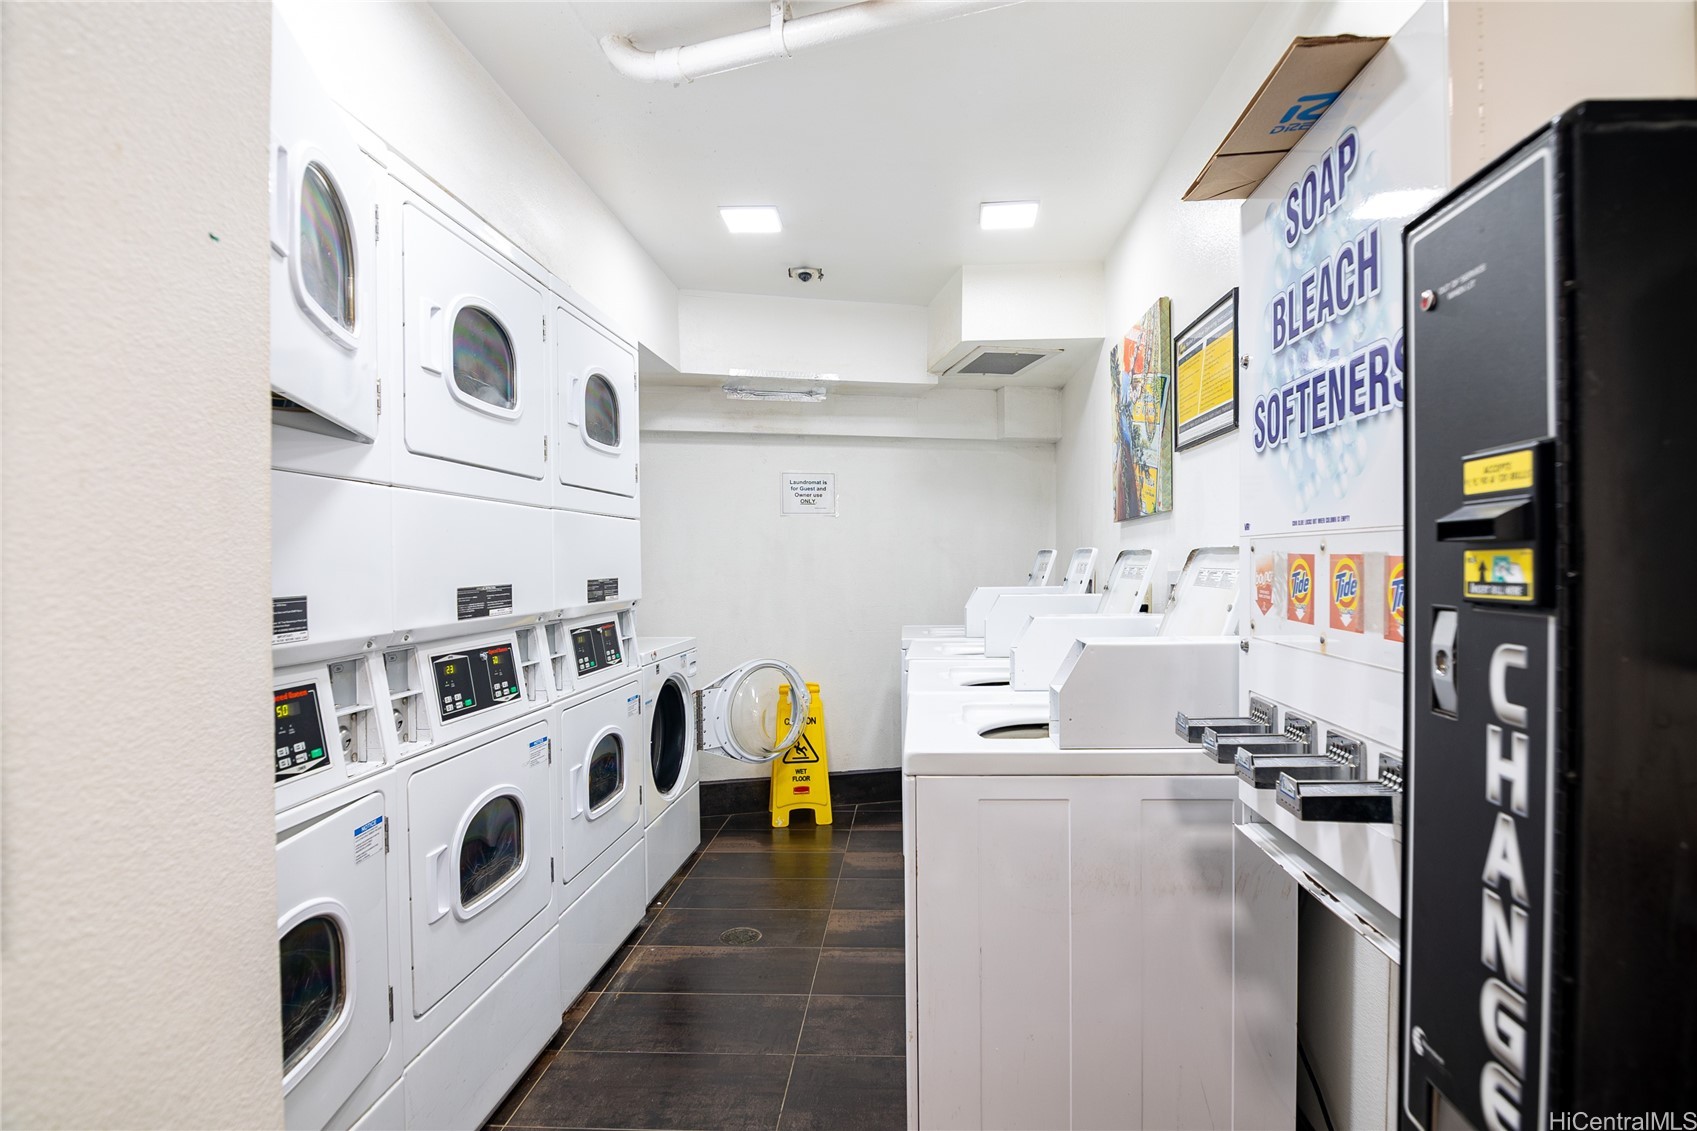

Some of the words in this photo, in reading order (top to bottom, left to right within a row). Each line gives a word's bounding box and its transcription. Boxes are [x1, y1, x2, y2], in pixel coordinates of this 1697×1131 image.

[1285, 129, 1358, 246] SOAP
[1271, 225, 1380, 353] BLEACH
[1291, 570, 1310, 599] Tide
[1335, 572, 1358, 603] Tide
[1391, 577, 1404, 613] Ti
[276, 704, 289, 718] 50
[1480, 643, 1529, 1131] CHANGE
